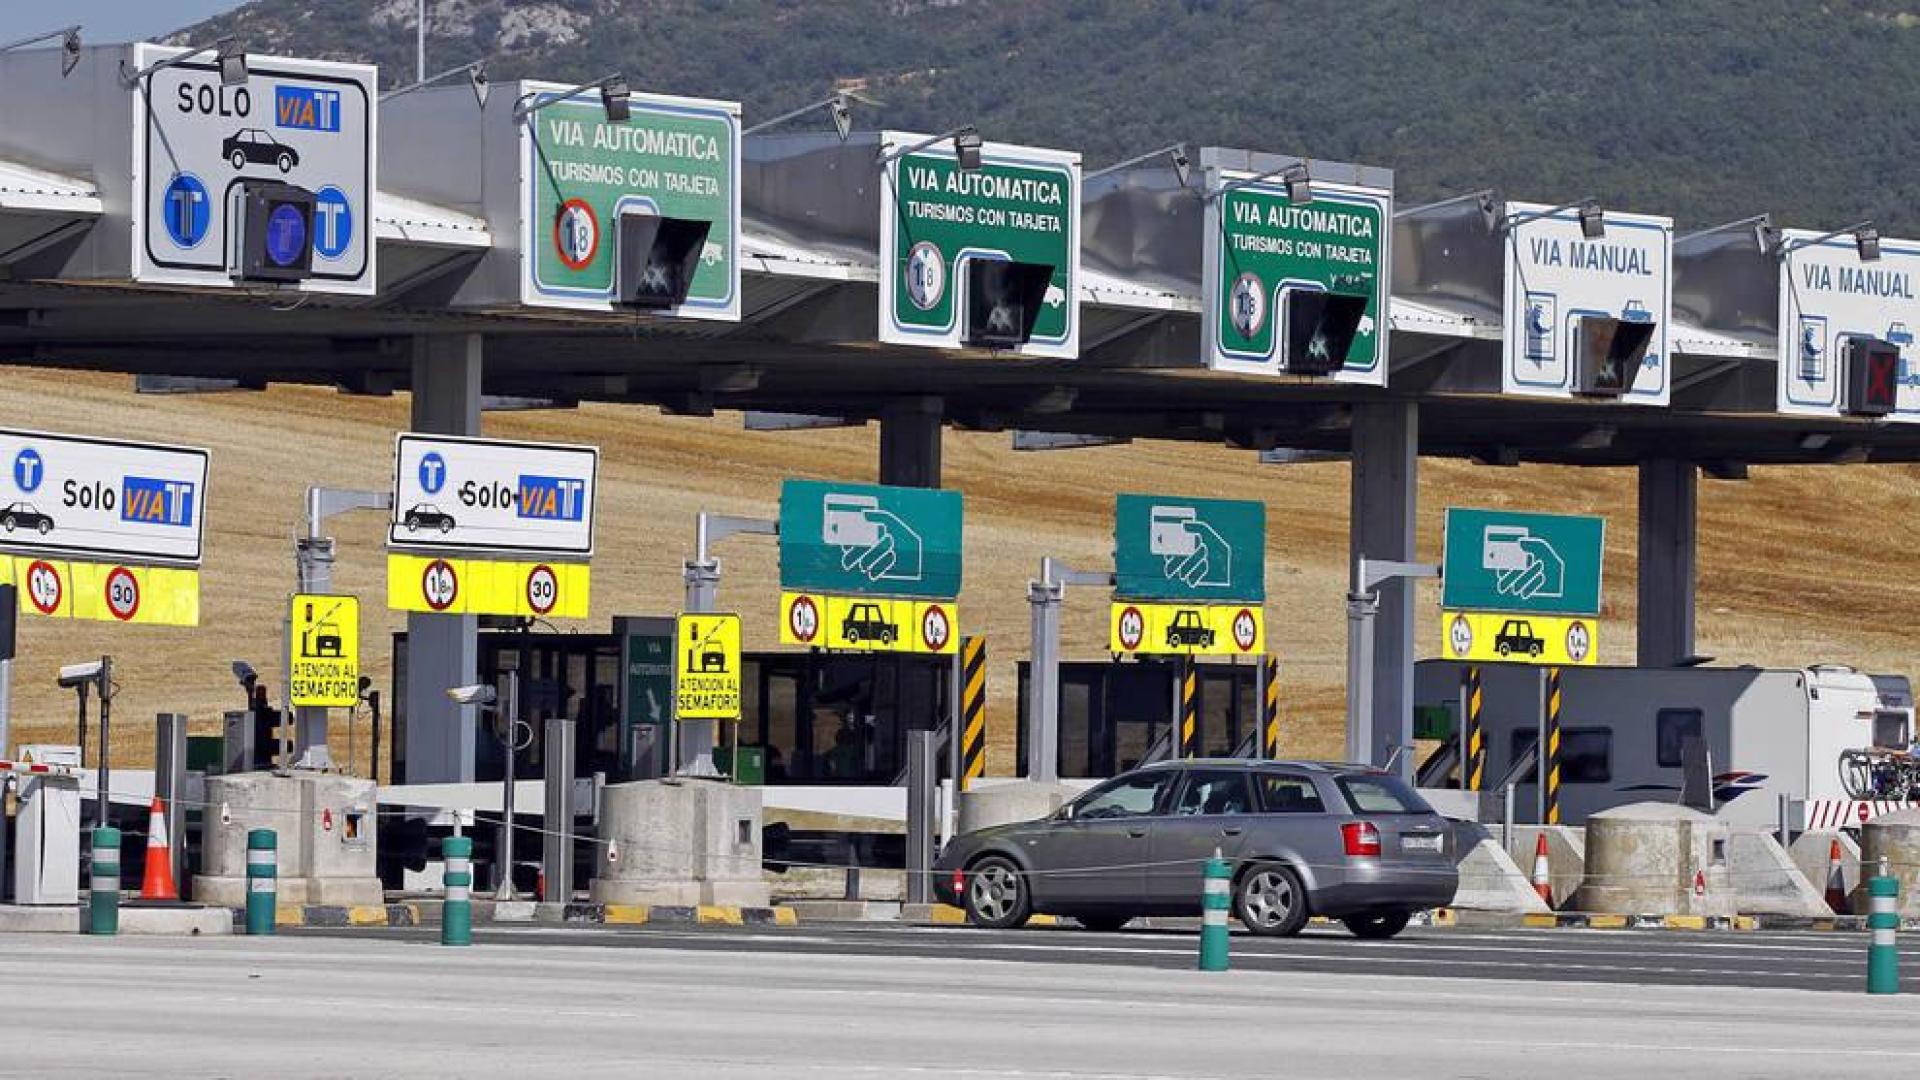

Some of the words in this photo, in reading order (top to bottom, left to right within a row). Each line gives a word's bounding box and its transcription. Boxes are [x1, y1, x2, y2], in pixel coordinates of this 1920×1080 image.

[178, 81, 250, 118] SOLO
[550, 119, 585, 148] VIA
[592, 123, 720, 162] AUTOMATICA
[550, 160, 624, 186] TURISMOS
[628, 167, 659, 189] CON
[664, 172, 719, 196] TARJETA
[907, 166, 939, 191] VIA
[945, 171, 1062, 205] AUTOMATICA
[907, 201, 974, 225] TURISMOS
[977, 210, 1005, 227] CON
[1009, 211, 1062, 233] TARJETA
[1233, 201, 1262, 225] VIA
[1267, 205, 1373, 239] AUTOMATICA
[1232, 233, 1293, 255] TURISMOS
[1296, 241, 1322, 259] CON
[1325, 244, 1372, 265] TARJETA
[1530, 237, 1562, 267] VIA
[1570, 242, 1653, 276] MANUAL
[1803, 263, 1832, 291] VIA
[1839, 267, 1915, 299] MANUAL
[62, 478, 115, 511] Solo
[461, 479, 511, 509] Solo
[112, 583, 133, 604] 30
[532, 580, 552, 598] 30
[344, 663, 356, 679] AL
[727, 678, 738, 692] AL
[292, 680, 356, 699] SEMAFORO
[680, 693, 738, 711] SEMAFORO
